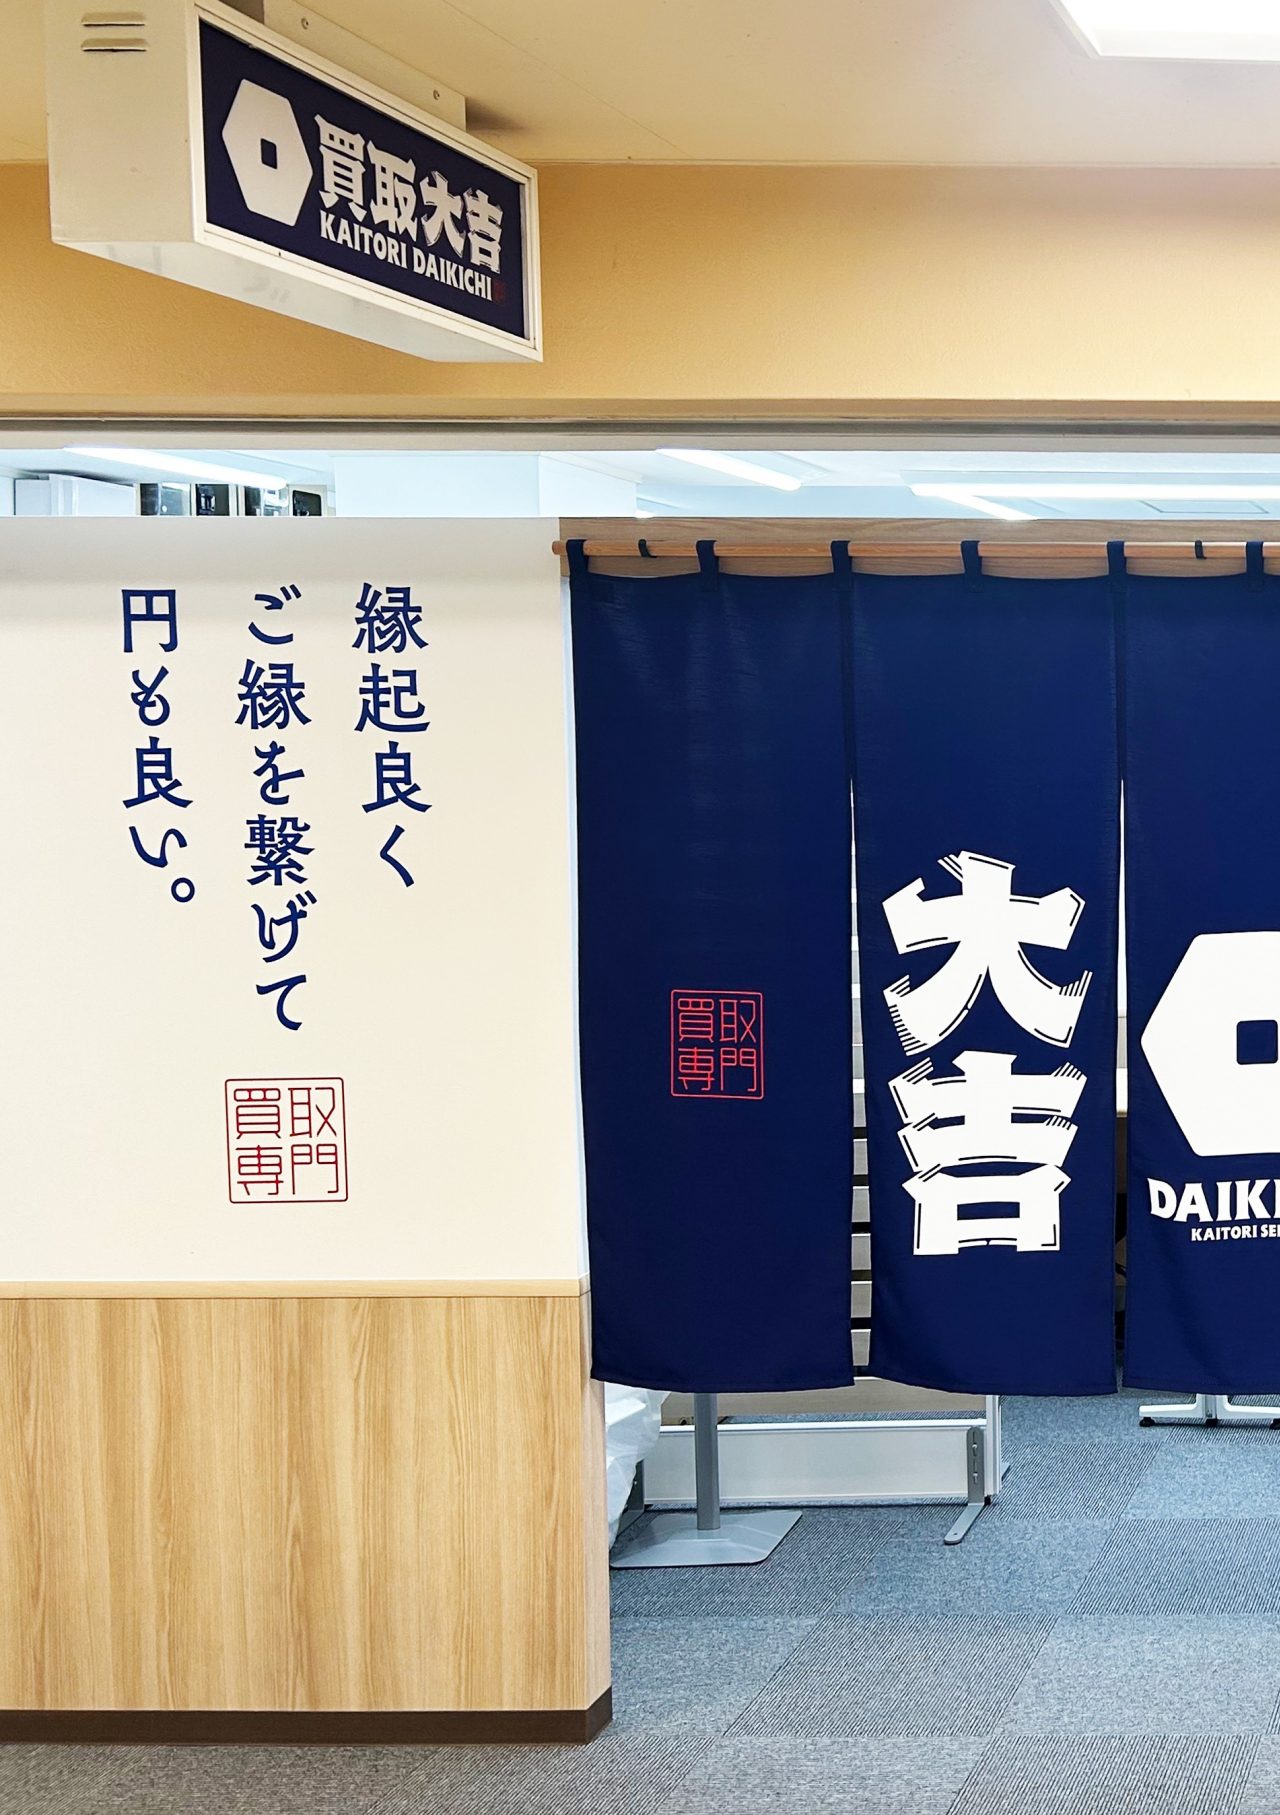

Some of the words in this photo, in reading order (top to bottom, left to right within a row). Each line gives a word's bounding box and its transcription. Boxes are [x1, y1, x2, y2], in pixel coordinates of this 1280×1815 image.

[314, 114, 503, 274] 買取大吉
[320, 210, 408, 269] KAITORI
[413, 246, 493, 301] DAIKICHI
[121, 588, 195, 904] 円も良い。
[235, 583, 317, 1031] ご縁を繋げて
[352, 582, 432, 888] 縁起良く
[882, 850, 1093, 1256] 大吉
[1190, 1225, 1258, 1242] KAITORI
